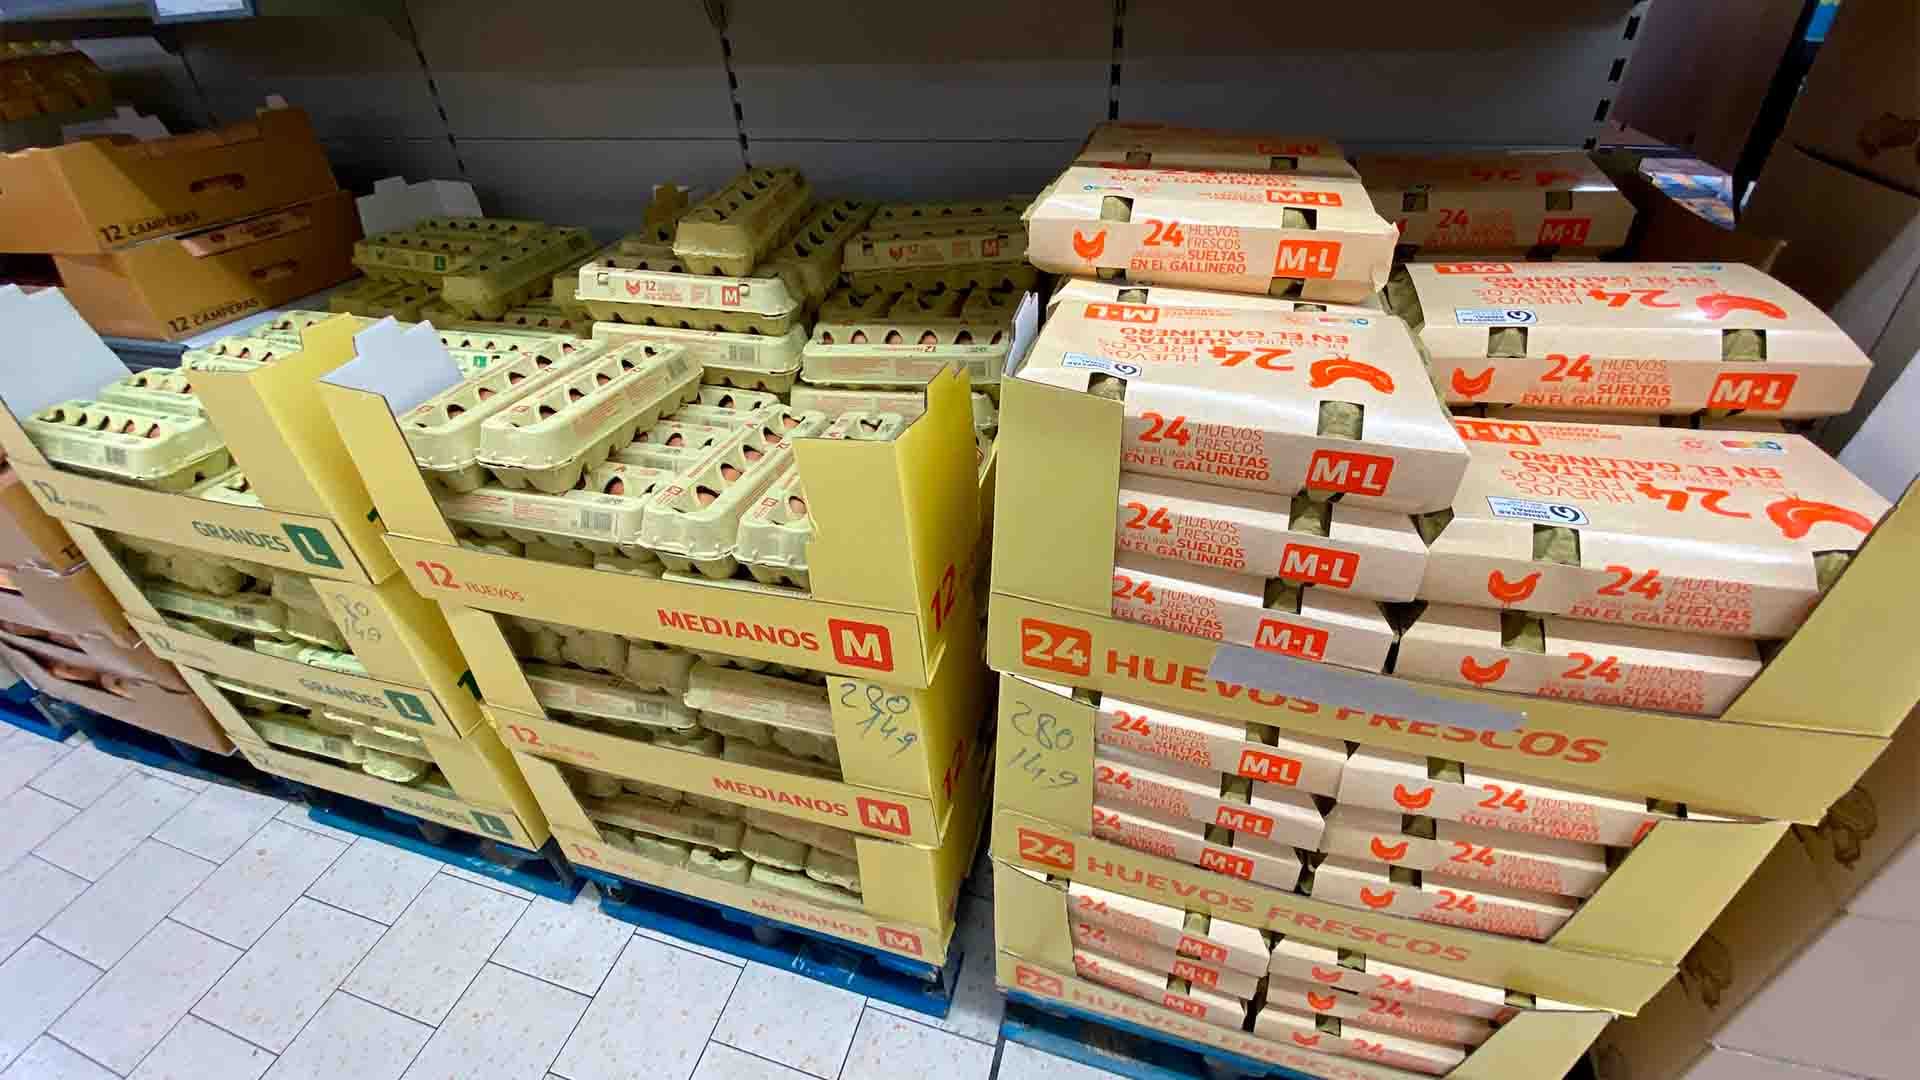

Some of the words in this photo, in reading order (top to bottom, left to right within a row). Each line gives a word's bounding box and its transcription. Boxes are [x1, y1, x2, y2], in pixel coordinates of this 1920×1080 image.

[1438, 208, 1470, 228] 24
[100, 224, 122, 243] 12
[1143, 218, 1185, 247] 24
[1187, 225, 1240, 238] HUEVOS
[1187, 238, 1241, 250] FRESCOS
[1130, 258, 1155, 271] EN
[1157, 259, 1169, 271] EL
[1170, 260, 1247, 274] GALLINERO
[1187, 250, 1246, 263] SUELTAS
[723, 287, 740, 305] M
[1587, 290, 1680, 309] 24
[168, 317, 188, 333] 12
[191, 298, 259, 326] CAMPERAS
[1120, 326, 1266, 341] GALLINERO
[1123, 337, 1231, 347] SUELTAS
[1311, 333, 1349, 344] EN
[1103, 349, 1200, 363] HUEVOS
[1207, 346, 1294, 371] 24
[1600, 360, 1668, 371] HUEVOS
[1540, 353, 1593, 384] 24
[1597, 372, 1668, 383] FRESCOS
[1521, 393, 1544, 405] EN
[1546, 394, 1565, 405] EL
[1573, 395, 1672, 408] GALLINERO
[1597, 384, 1671, 397] SUELTAS
[1138, 409, 1190, 446] 24
[1196, 423, 1263, 441] HUEVOS
[1194, 438, 1264, 455] FRESCOS
[1120, 451, 1145, 465] EN
[1150, 452, 1166, 466] EL
[1173, 459, 1270, 481] GALLINERO
[1196, 451, 1268, 470] SUELTAS
[1508, 450, 1681, 474] GALLINERO
[1689, 464, 1723, 477] EL
[1500, 467, 1625, 492] FRESCOS
[1522, 461, 1653, 483] SUELTAS
[1734, 466, 1783, 480] EN
[1515, 482, 1635, 504] HUEVOS
[1633, 483, 1752, 518] 24
[1125, 502, 1173, 534] 24
[1176, 512, 1238, 534] HUEVOS
[191, 520, 290, 553] GRANDES
[293, 529, 336, 565] L
[1176, 525, 1240, 546] FRESCOS
[1135, 541, 1148, 552] EL
[1156, 545, 1246, 569] GALLINERO
[1176, 538, 1245, 558] SUELTAS
[416, 560, 461, 589] 12
[1597, 565, 1663, 600] 24
[1671, 577, 1752, 594] HUEVOS
[931, 564, 956, 633] 12
[1112, 575, 1155, 605] 24
[1161, 588, 1216, 609] HUEVOS
[1160, 608, 1223, 630] SUELTAS
[1570, 605, 1598, 619] EN
[1602, 607, 1625, 621] EL
[1632, 609, 1751, 633] GALLINERO
[1663, 602, 1752, 622] SUELTAS
[656, 608, 820, 651] MEDIANOS
[838, 625, 888, 666] M
[1141, 613, 1224, 641] GALLINERO
[1022, 625, 1090, 670] 24
[1561, 653, 1622, 683] 24
[299, 677, 389, 709] GRANDES
[395, 693, 428, 722] L
[839, 682, 912, 716] 280
[1536, 686, 1563, 698] EN
[1568, 688, 1588, 700] EL
[1010, 700, 1074, 751] 280
[1111, 710, 1151, 737] 24
[508, 724, 543, 746] 12
[1097, 765, 1134, 790] 24
[712, 776, 850, 817] MEDIANOS
[865, 801, 905, 832] M
[1476, 784, 1528, 814] 24
[480, 815, 508, 839] L
[1093, 810, 1121, 831] 24
[1450, 841, 1497, 867] 24
[1019, 832, 1073, 869] 24
[1088, 855, 1256, 913] HUEVOS
[1266, 906, 1471, 963] FRESCOS
[1079, 895, 1107, 914] 24
[1434, 889, 1478, 914] 24
[882, 930, 918, 955] M
[1079, 924, 1106, 943] 24
[1379, 973, 1415, 993] 24
[1368, 993, 1405, 1018] 24
[1353, 1038, 1385, 1056] 24
